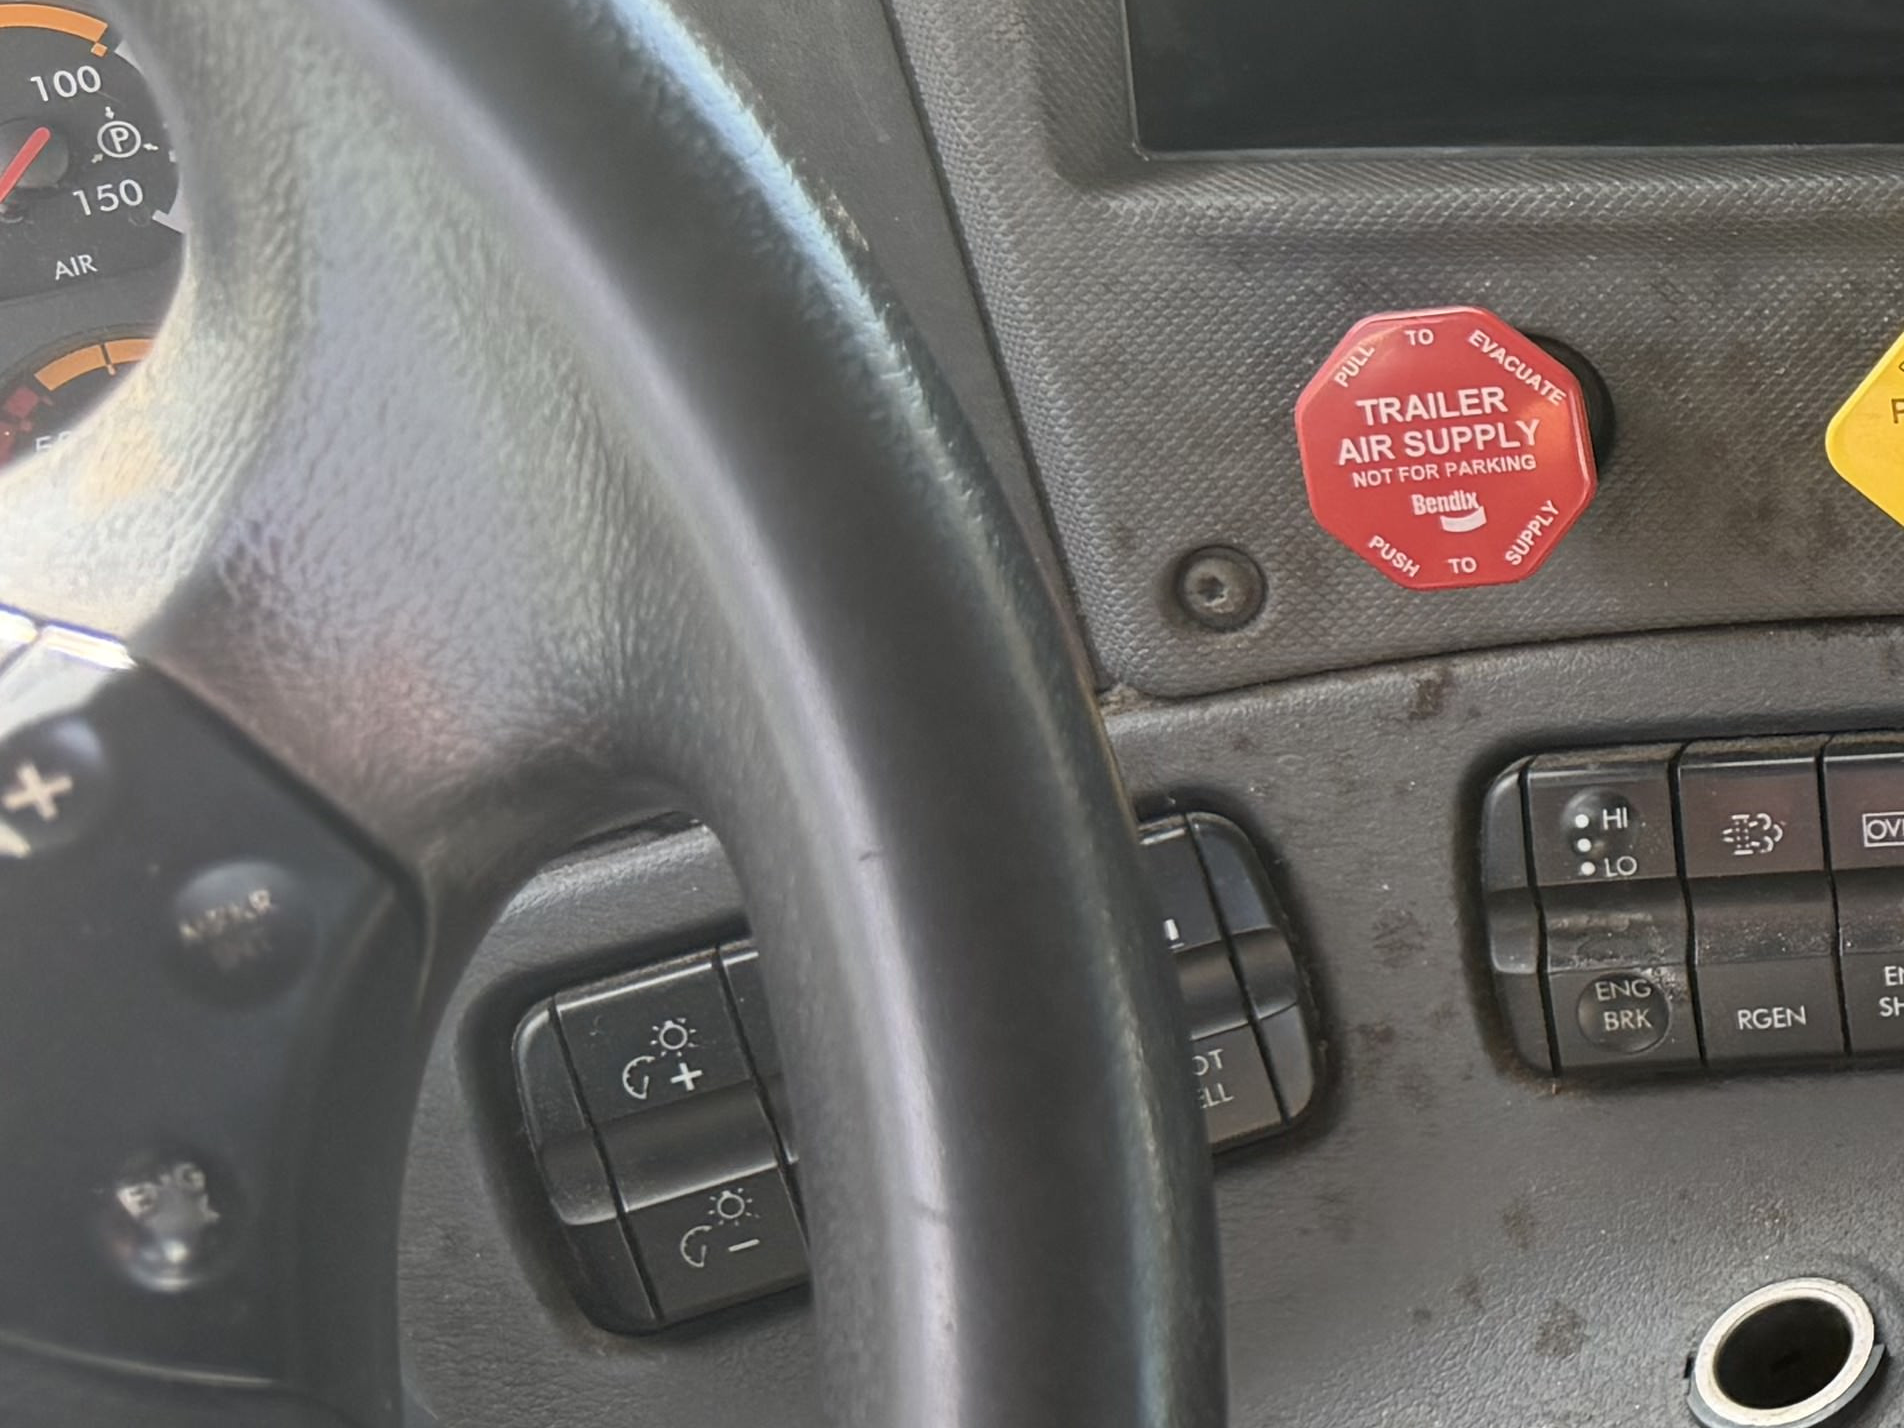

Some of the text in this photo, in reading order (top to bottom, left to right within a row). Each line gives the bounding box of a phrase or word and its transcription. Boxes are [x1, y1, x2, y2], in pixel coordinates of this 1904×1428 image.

[30, 64, 102, 103] 100
[110, 126, 130, 152] P
[72, 177, 145, 217] 150
[54, 253, 98, 282] AIR
[1334, 328, 1567, 407] PULL TO EVACUATE
[1355, 387, 1508, 426] TRAILER
[1337, 419, 1541, 466] AIR SUPPLY
[1352, 454, 1537, 489] NOT FOR PARKING
[1411, 490, 1480, 516] Bendix
[1368, 499, 1559, 578] PUSH TO SUPPLY
[1602, 807, 1629, 830] HI
[1603, 855, 1638, 878] LO
[1594, 978, 1653, 1001] ENG
[1603, 1008, 1653, 1032] BRK
[1736, 1005, 1808, 1031] RGEN
